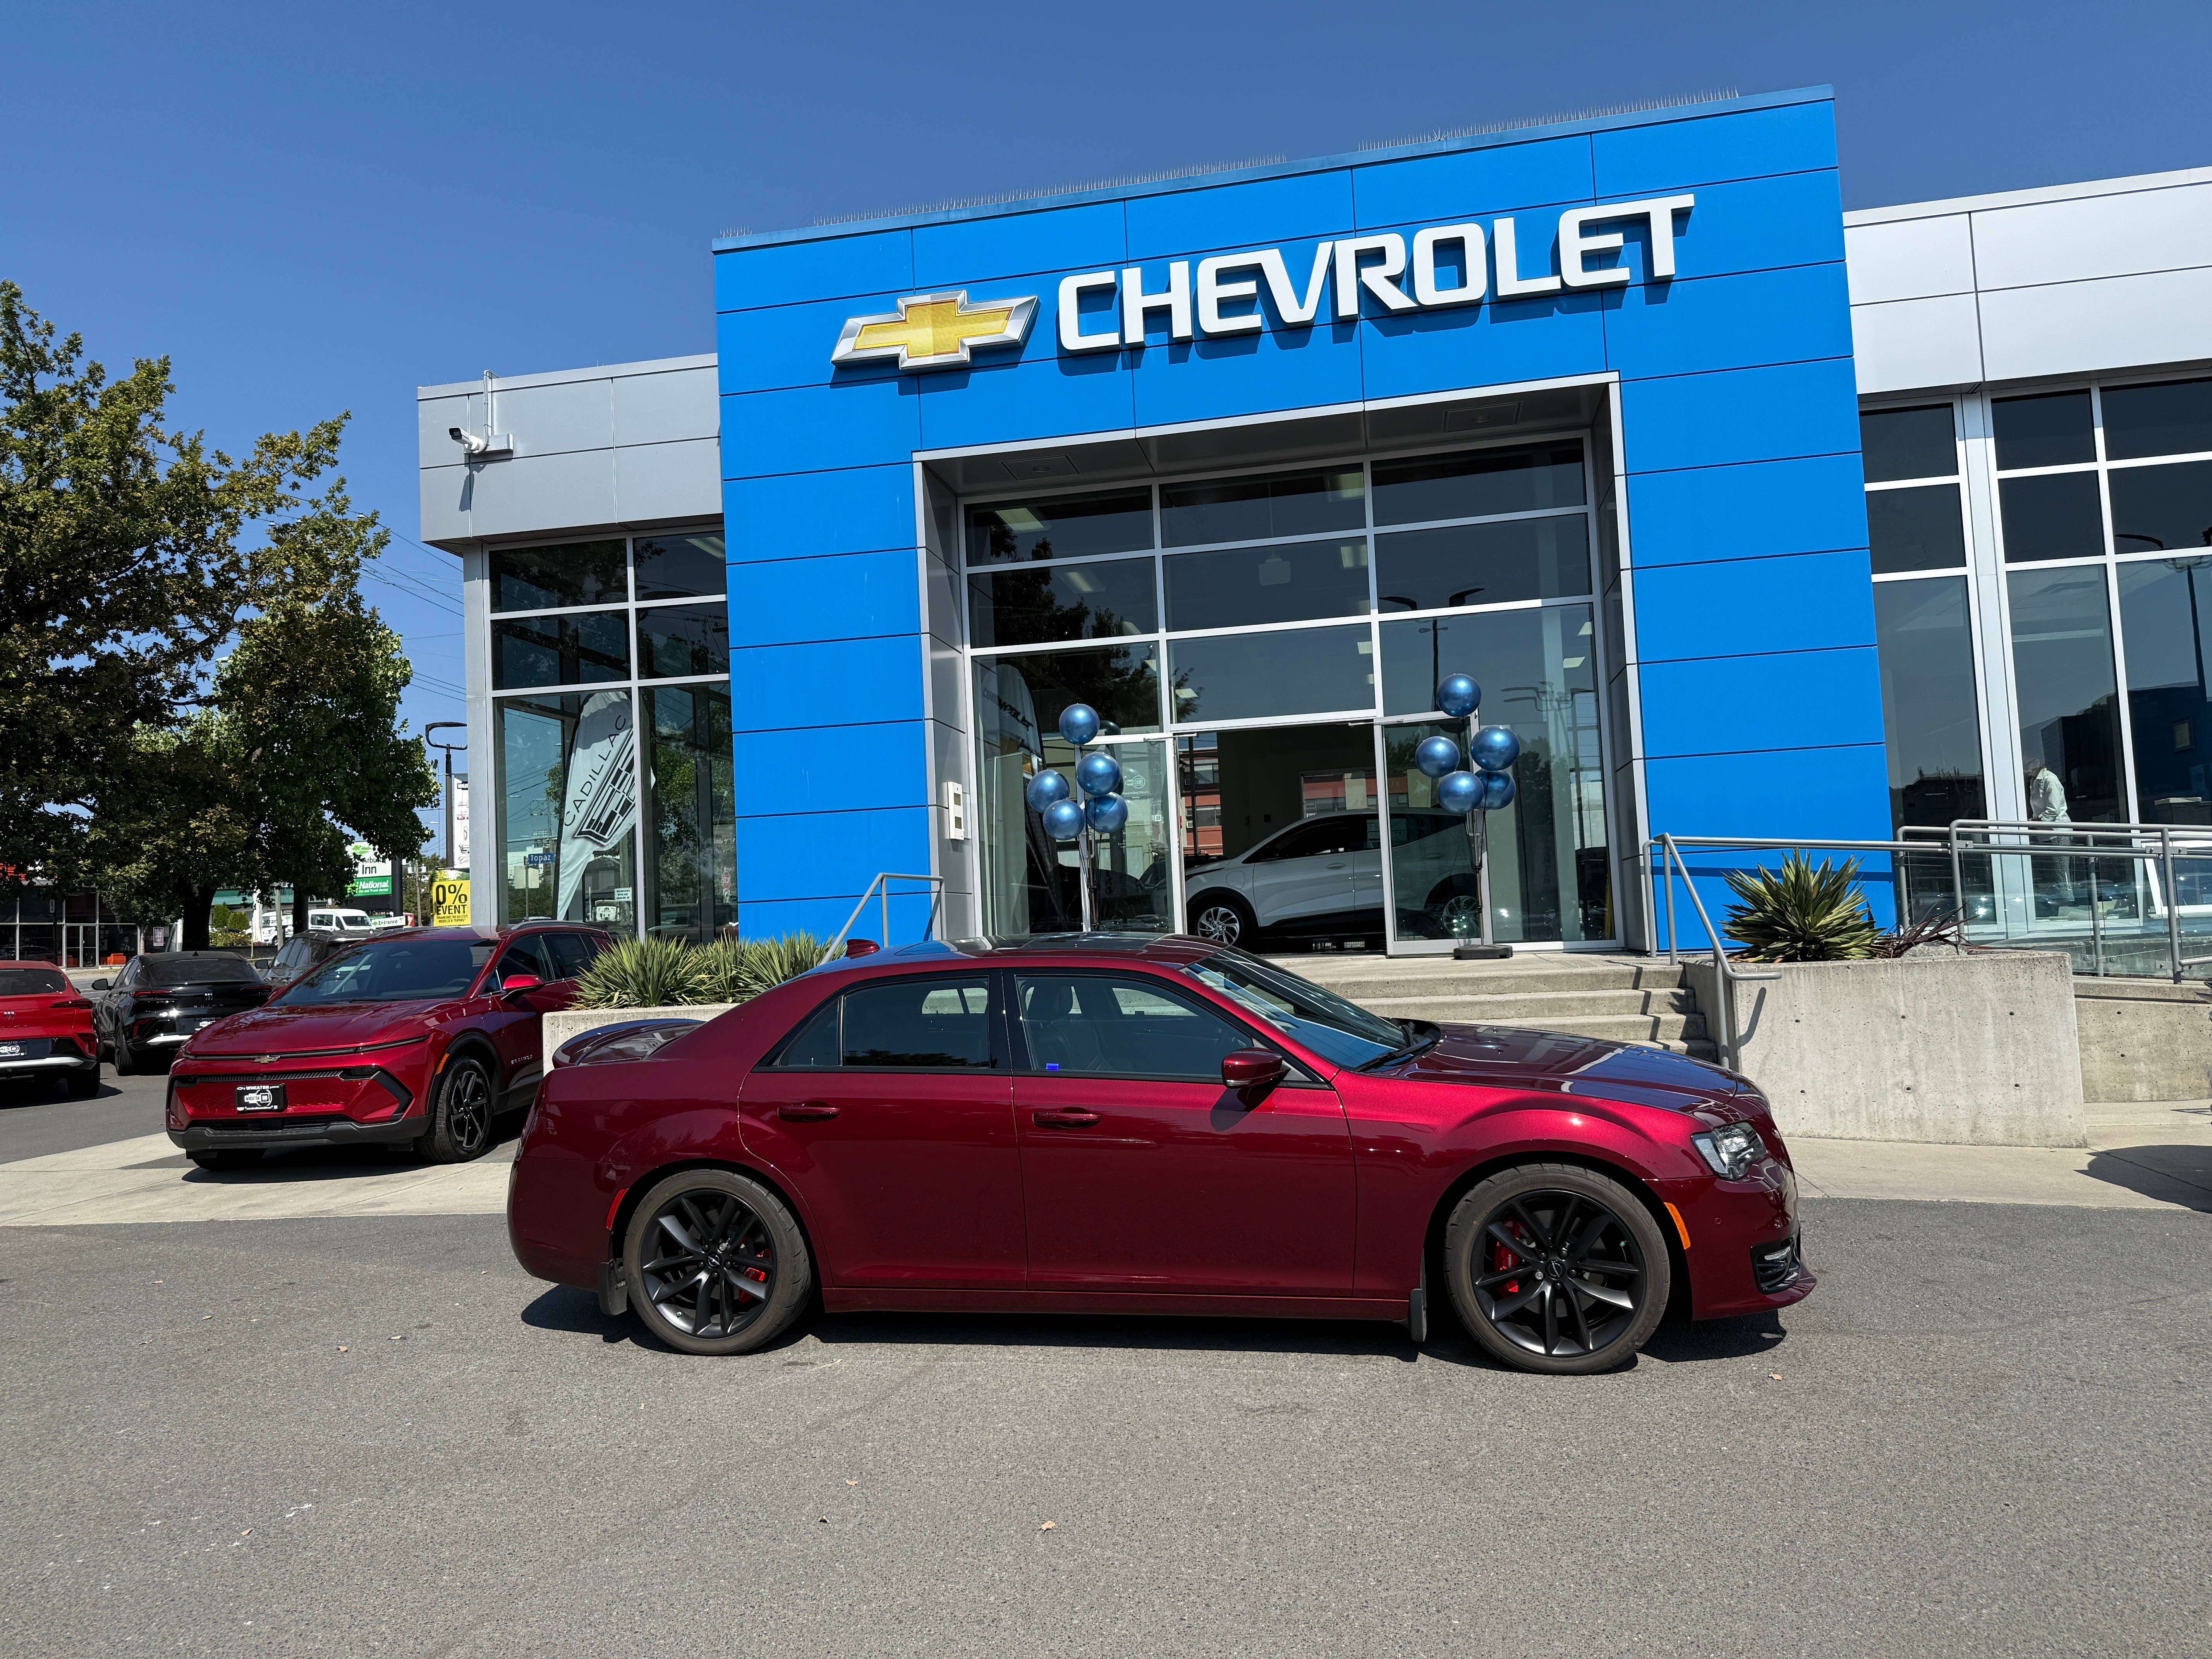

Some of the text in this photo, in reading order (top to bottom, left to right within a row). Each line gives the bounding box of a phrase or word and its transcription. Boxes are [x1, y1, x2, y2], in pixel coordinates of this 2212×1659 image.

[1058, 194, 1695, 356] CHEVROLET
[564, 715, 626, 826] CADILLAC
[362, 864, 376, 874] Inn
[436, 883, 467, 905] 0%
[436, 904, 467, 915] EVENT
